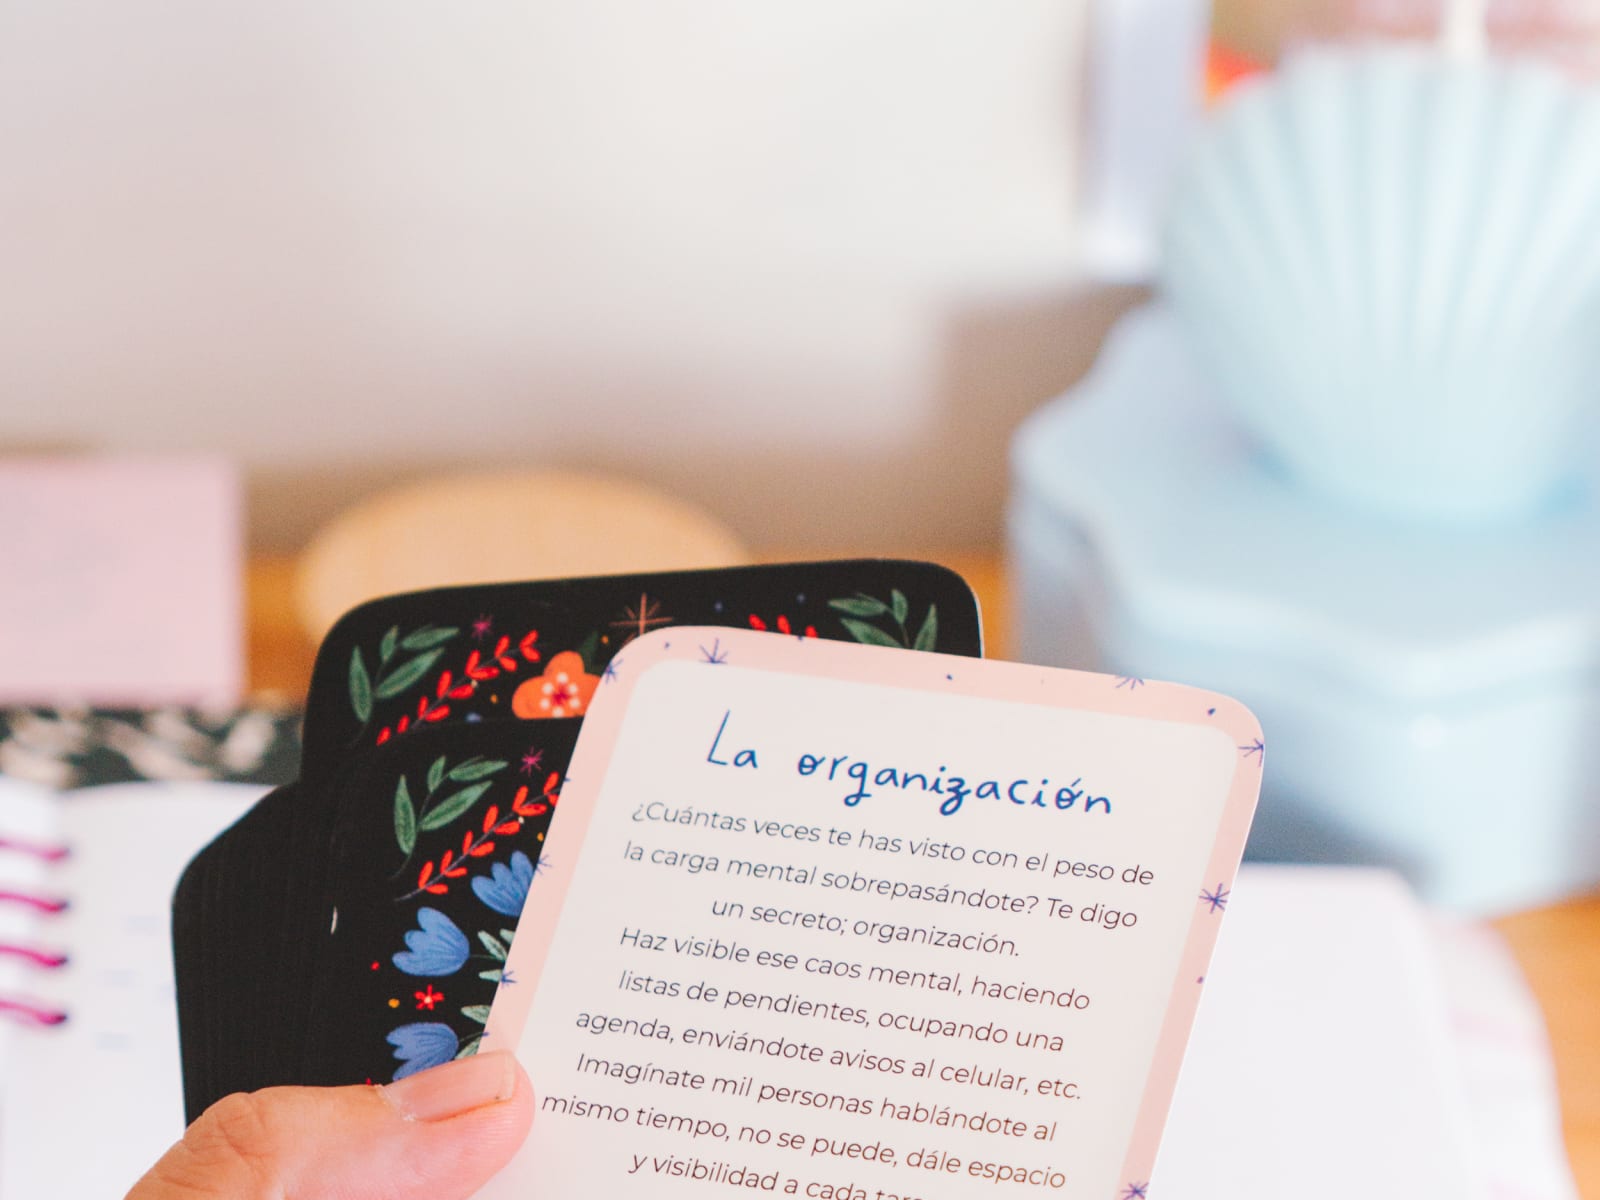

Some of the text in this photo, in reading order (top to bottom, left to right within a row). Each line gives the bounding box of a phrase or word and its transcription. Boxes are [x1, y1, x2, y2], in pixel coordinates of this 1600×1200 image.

[706, 709, 1112, 817] La organización
[623, 840, 1138, 930] la carga mental sobrepasándote? Te digo
[631, 801, 1155, 886] ¿Cuántas veces te has visto con el peso de
[619, 927, 1091, 1010] Haz visible ese caos mental, haciendo
[711, 900, 1020, 957] un secreto; organización.
[618, 969, 1064, 1052] listas de pendientes, ocupando una
[575, 1012, 1081, 1100] agenda, enviándote avisos al celular, etc.
[576, 1052, 1057, 1142] Imagínate mil personas hablándote al
[541, 1095, 1066, 1189] mismo tiempo, no se puede, dále espacio
[627, 1153, 648, 1175] y
[653, 1154, 780, 1192] visibilidad
[783, 1178, 799, 1195] a
